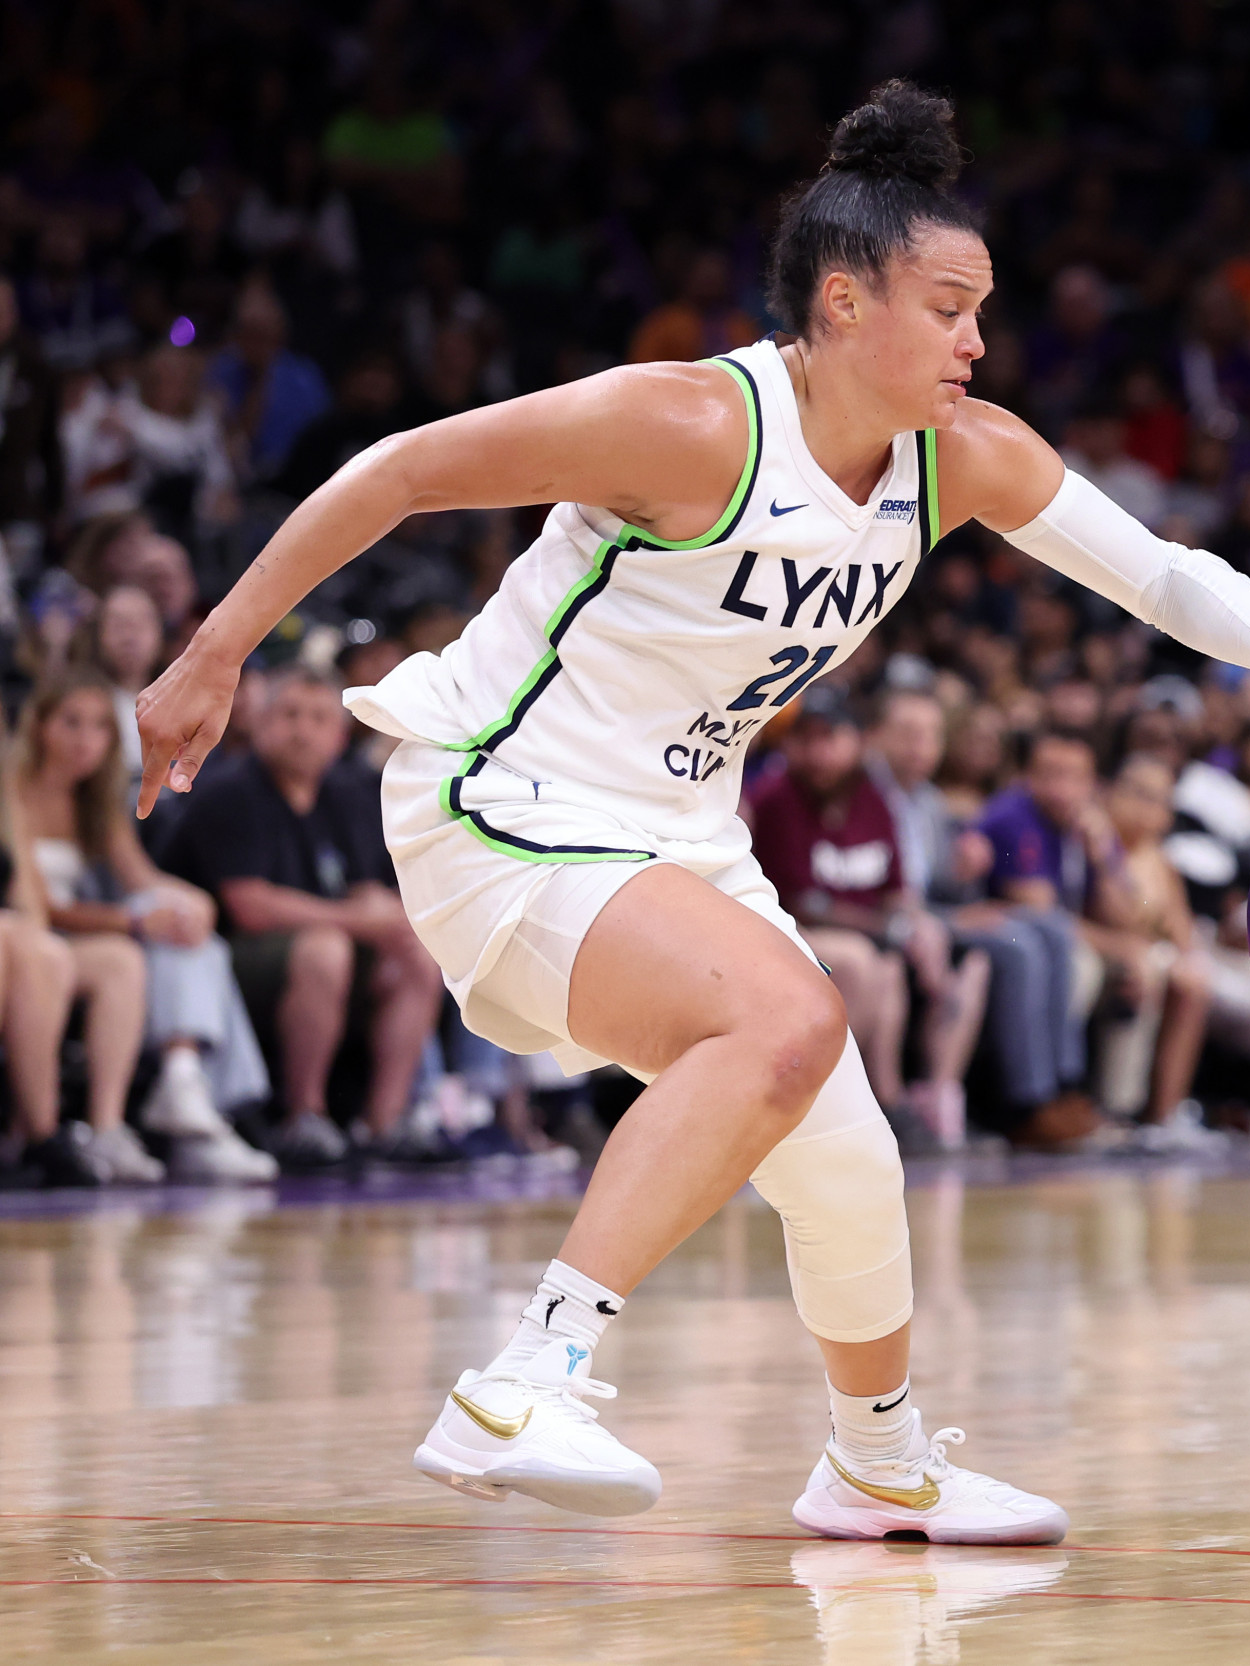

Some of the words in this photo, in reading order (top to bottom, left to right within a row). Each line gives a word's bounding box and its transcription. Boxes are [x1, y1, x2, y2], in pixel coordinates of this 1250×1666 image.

[873, 511, 908, 520] NSURANCE
[720, 550, 904, 628] LYNX
[726, 645, 838, 711] 21
